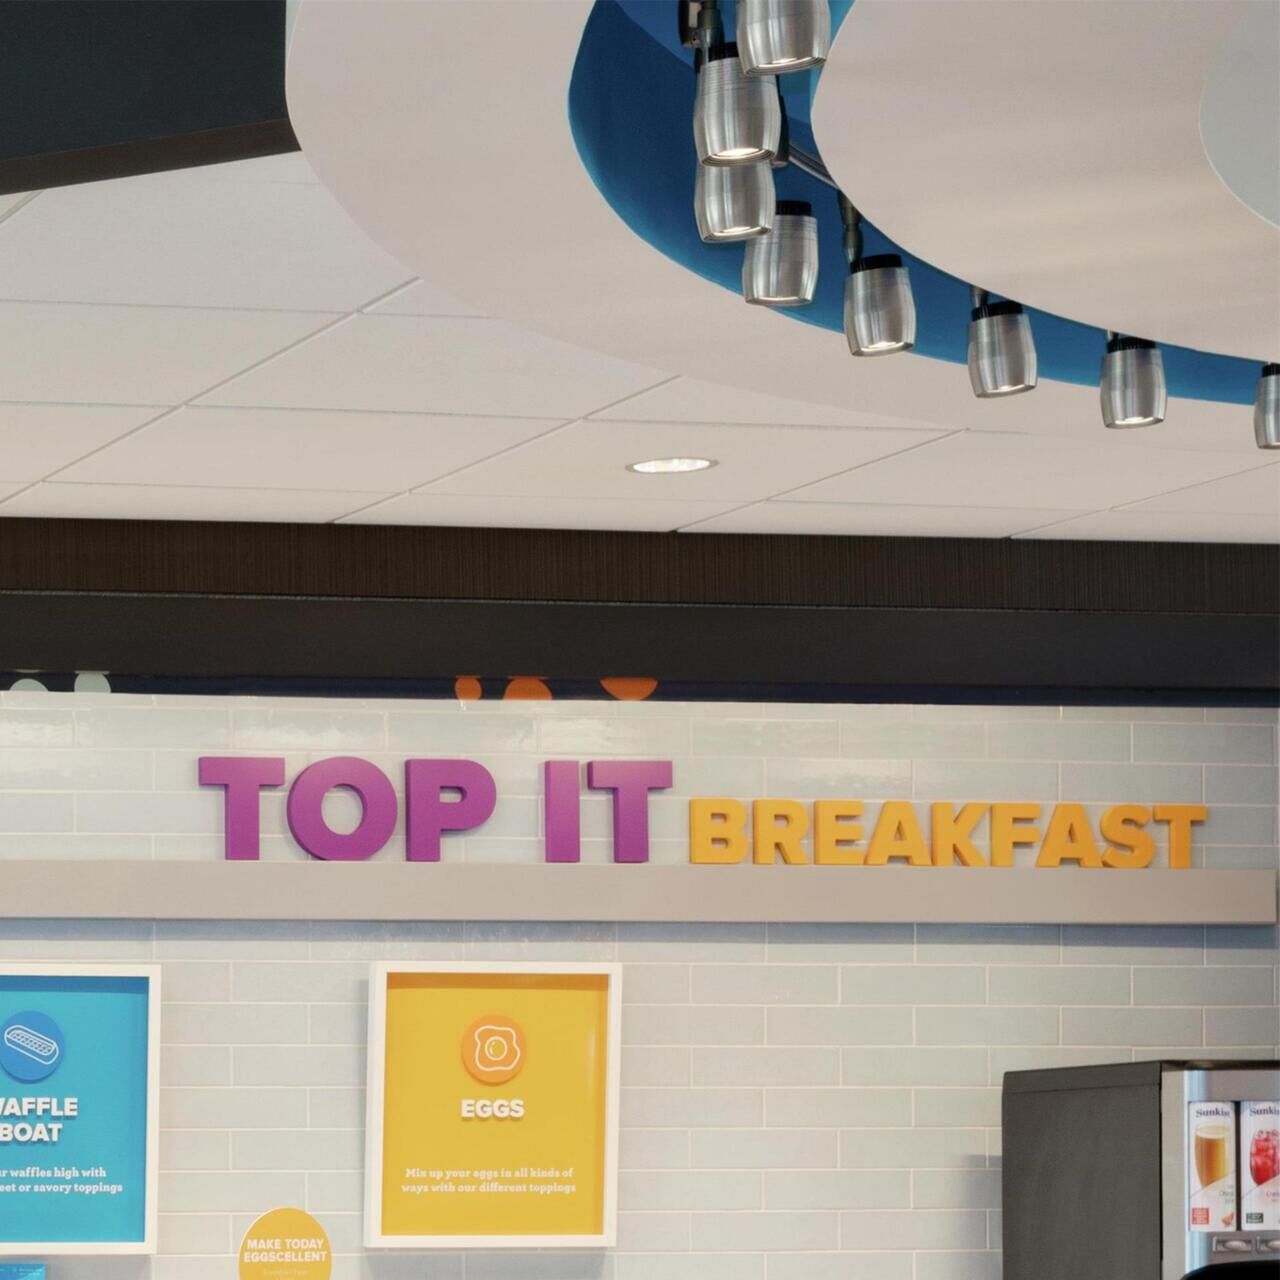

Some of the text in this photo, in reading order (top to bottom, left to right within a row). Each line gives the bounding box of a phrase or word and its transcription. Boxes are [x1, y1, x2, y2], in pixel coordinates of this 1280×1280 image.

[198, 756, 674, 864] TOP IT
[688, 798, 1208, 870] BREAKFAST
[461, 1099, 525, 1118] EGGS
[10, 1167, 52, 1179] waffles
[54, 1167, 79, 1181] high
[81, 1167, 107, 1179] with
[406, 1167, 573, 1182] Mix up your eggs in all kinds of
[18, 1185, 32, 1193] or
[33, 1185, 72, 1196] savory
[73, 1182, 123, 1196] toppings
[401, 1181, 576, 1196] ways with our different toppings
[247, 1238, 324, 1249] MAKE TODAY
[244, 1251, 327, 1262] EGGSCELLENT
